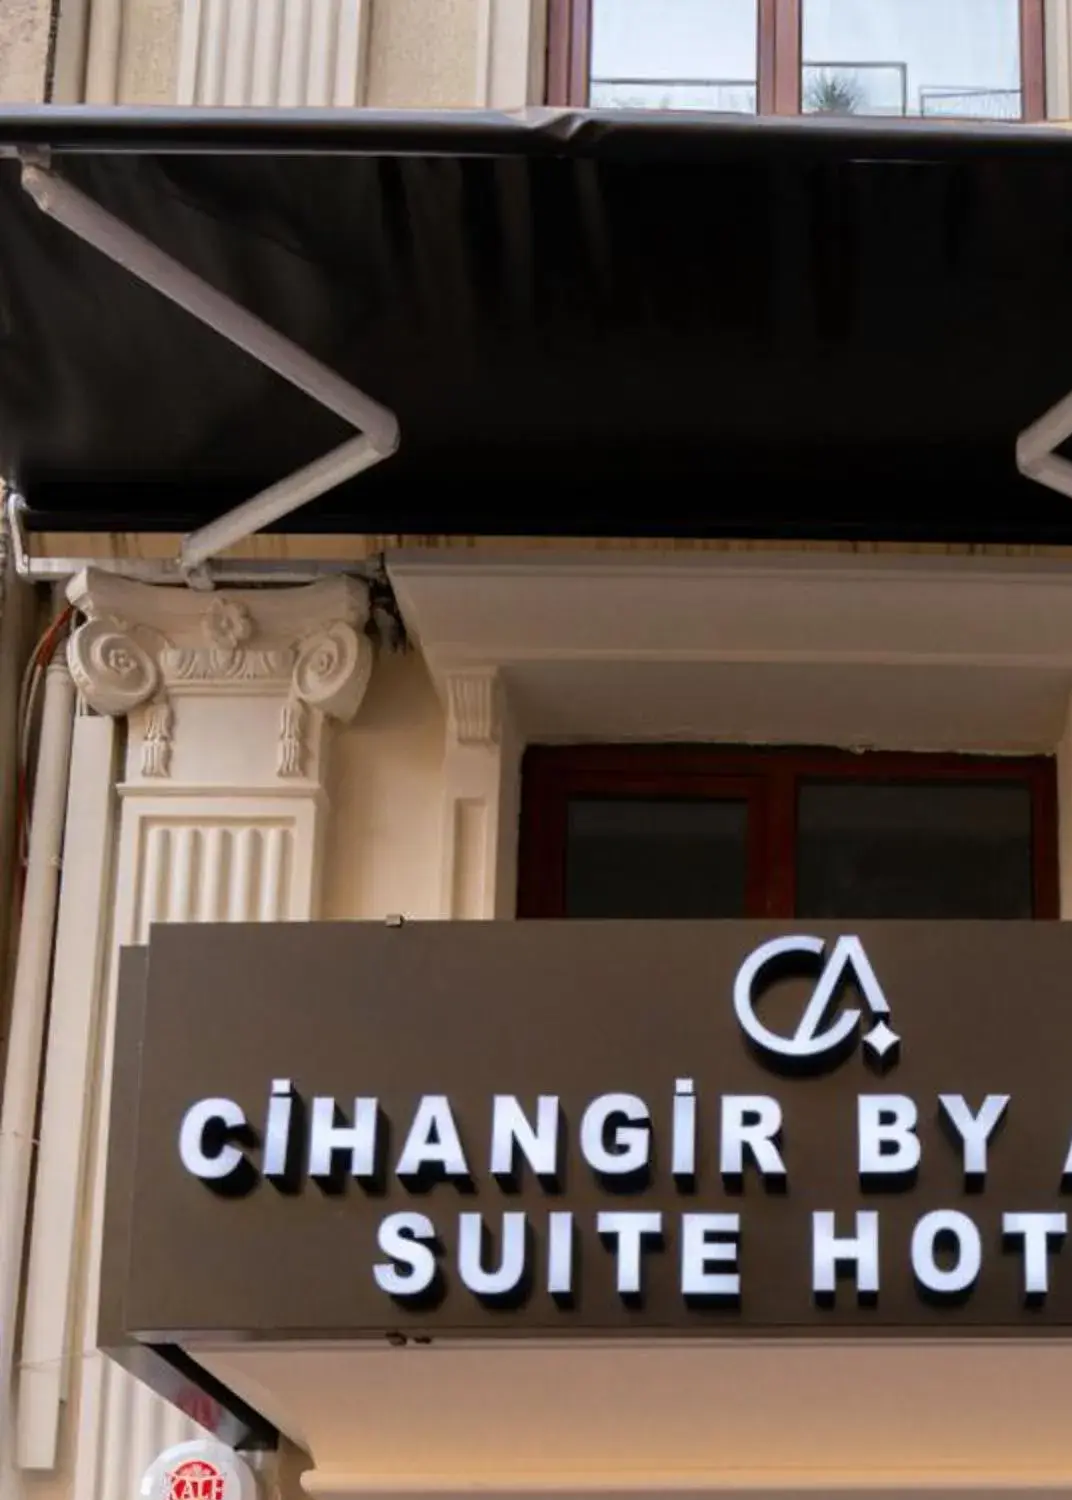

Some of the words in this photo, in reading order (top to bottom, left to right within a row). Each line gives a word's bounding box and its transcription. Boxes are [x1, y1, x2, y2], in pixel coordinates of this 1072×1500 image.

[179, 1078, 786, 1178] CİHANGİR
[858, 1094, 1010, 1173] BY
[373, 1212, 739, 1294] SUITE
